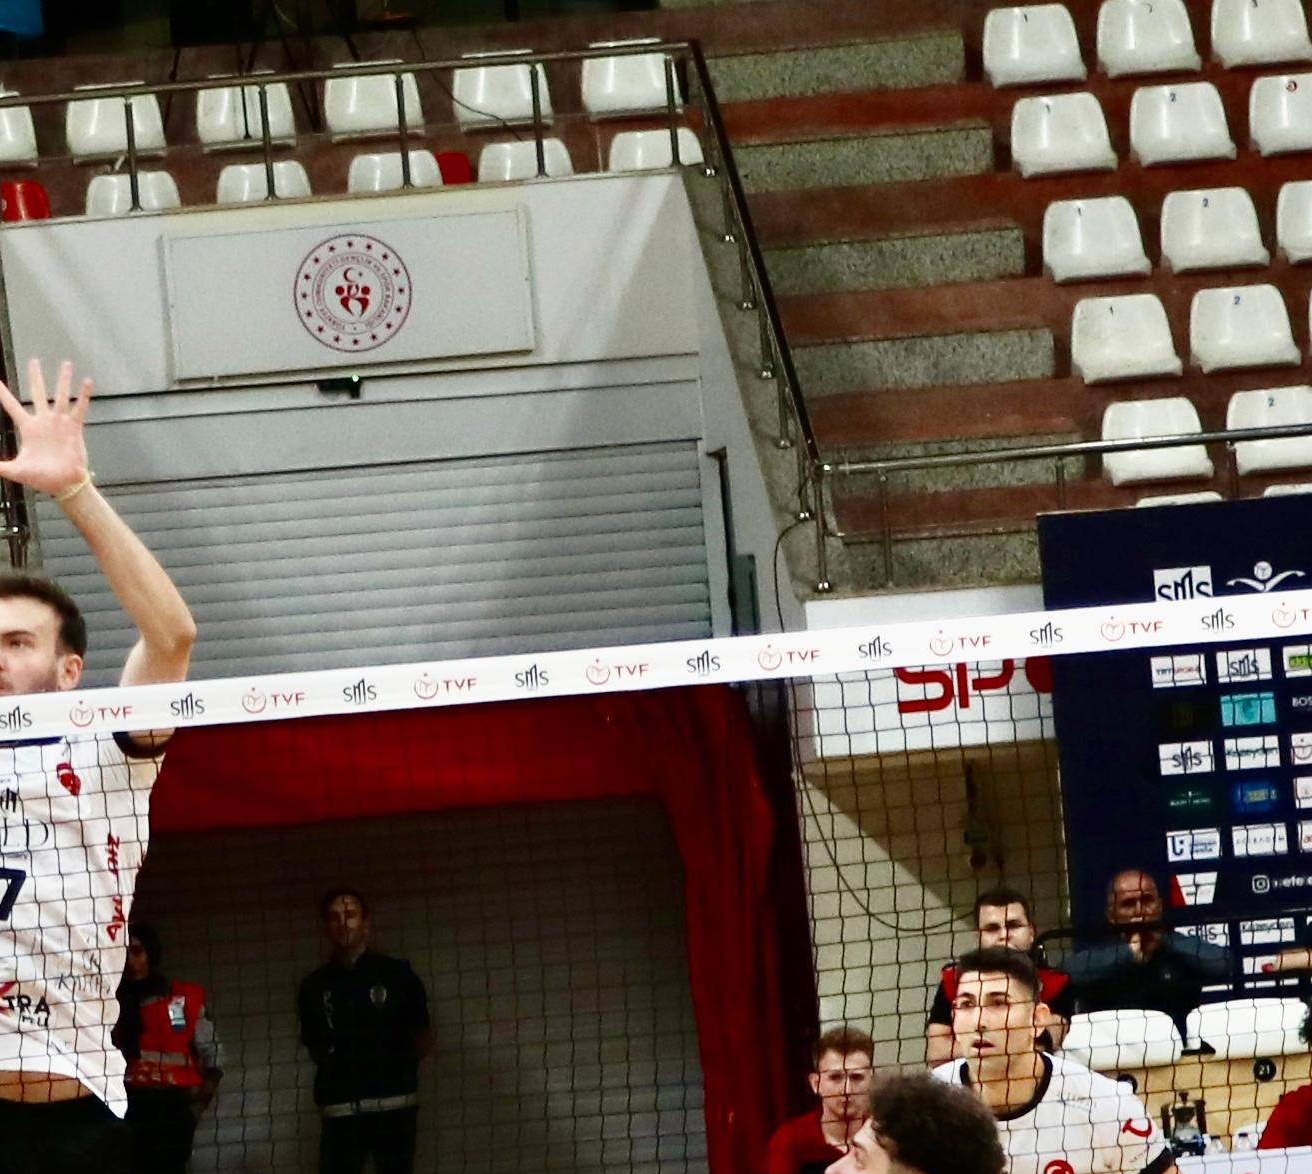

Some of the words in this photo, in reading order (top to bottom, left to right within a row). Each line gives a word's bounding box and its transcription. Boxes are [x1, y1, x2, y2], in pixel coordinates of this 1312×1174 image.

[98, 705, 133, 719] TVF
[170, 692, 205, 717] SMS
[271, 692, 306, 706] TVF
[343, 678, 377, 703] SMS
[442, 677, 477, 691] TVF
[515, 664, 549, 689] SMS
[613, 664, 649, 678] TVF
[687, 650, 721, 675] SMS
[786, 650, 821, 663] TVF
[858, 635, 893, 660] SMS
[958, 636, 992, 649] TVF
[1030, 622, 1064, 645] SMS
[1129, 621, 1164, 634] TVF
[1201, 608, 1235, 631] SMS
[1259, 1064, 1270, 1075] 21
